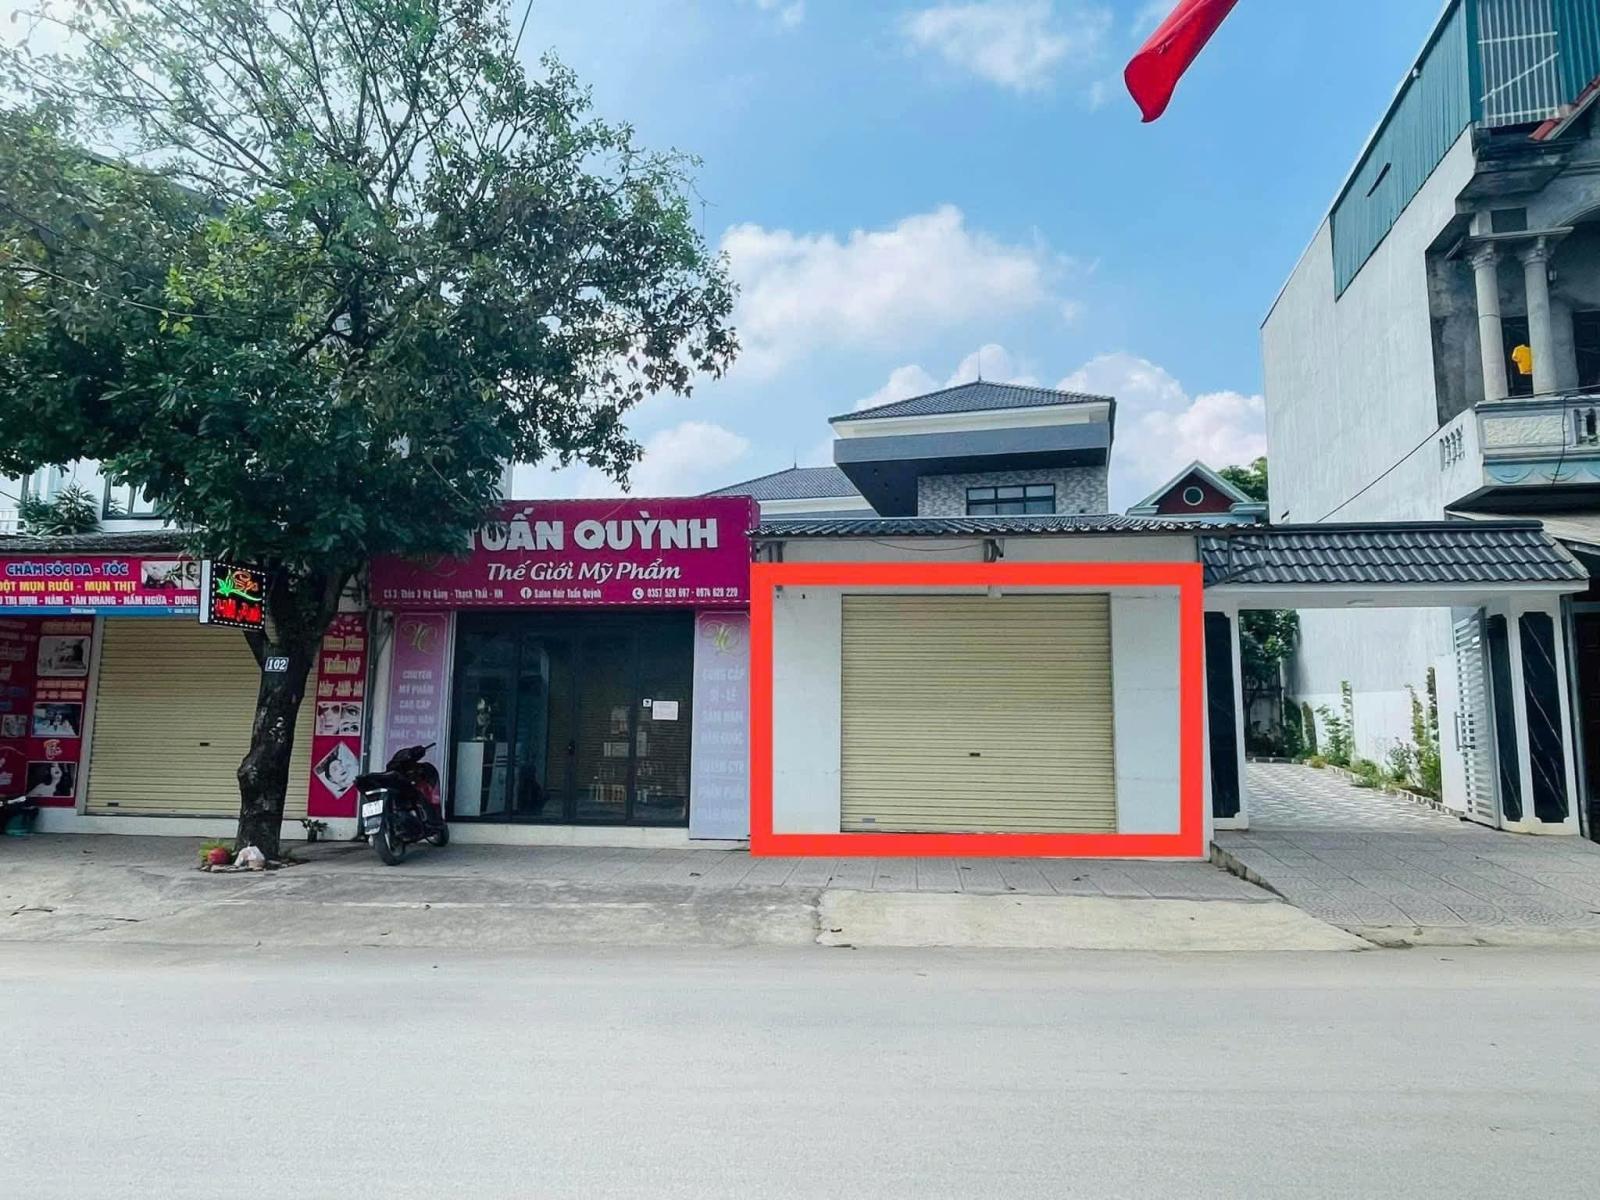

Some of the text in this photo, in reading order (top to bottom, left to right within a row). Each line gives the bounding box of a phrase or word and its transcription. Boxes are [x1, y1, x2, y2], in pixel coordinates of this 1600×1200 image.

[573, 510, 718, 551] QUỲNH
[44, 560, 73, 576] SÓC
[73, 563, 93, 576] DA
[102, 560, 129, 576] TÓC
[487, 558, 681, 584] Thế Giới Mỹ Phẩm
[19, 581, 45, 594] MỤN
[84, 581, 111, 594] MỤN
[114, 580, 137, 594] THỊT
[268, 659, 287, 670] 102
